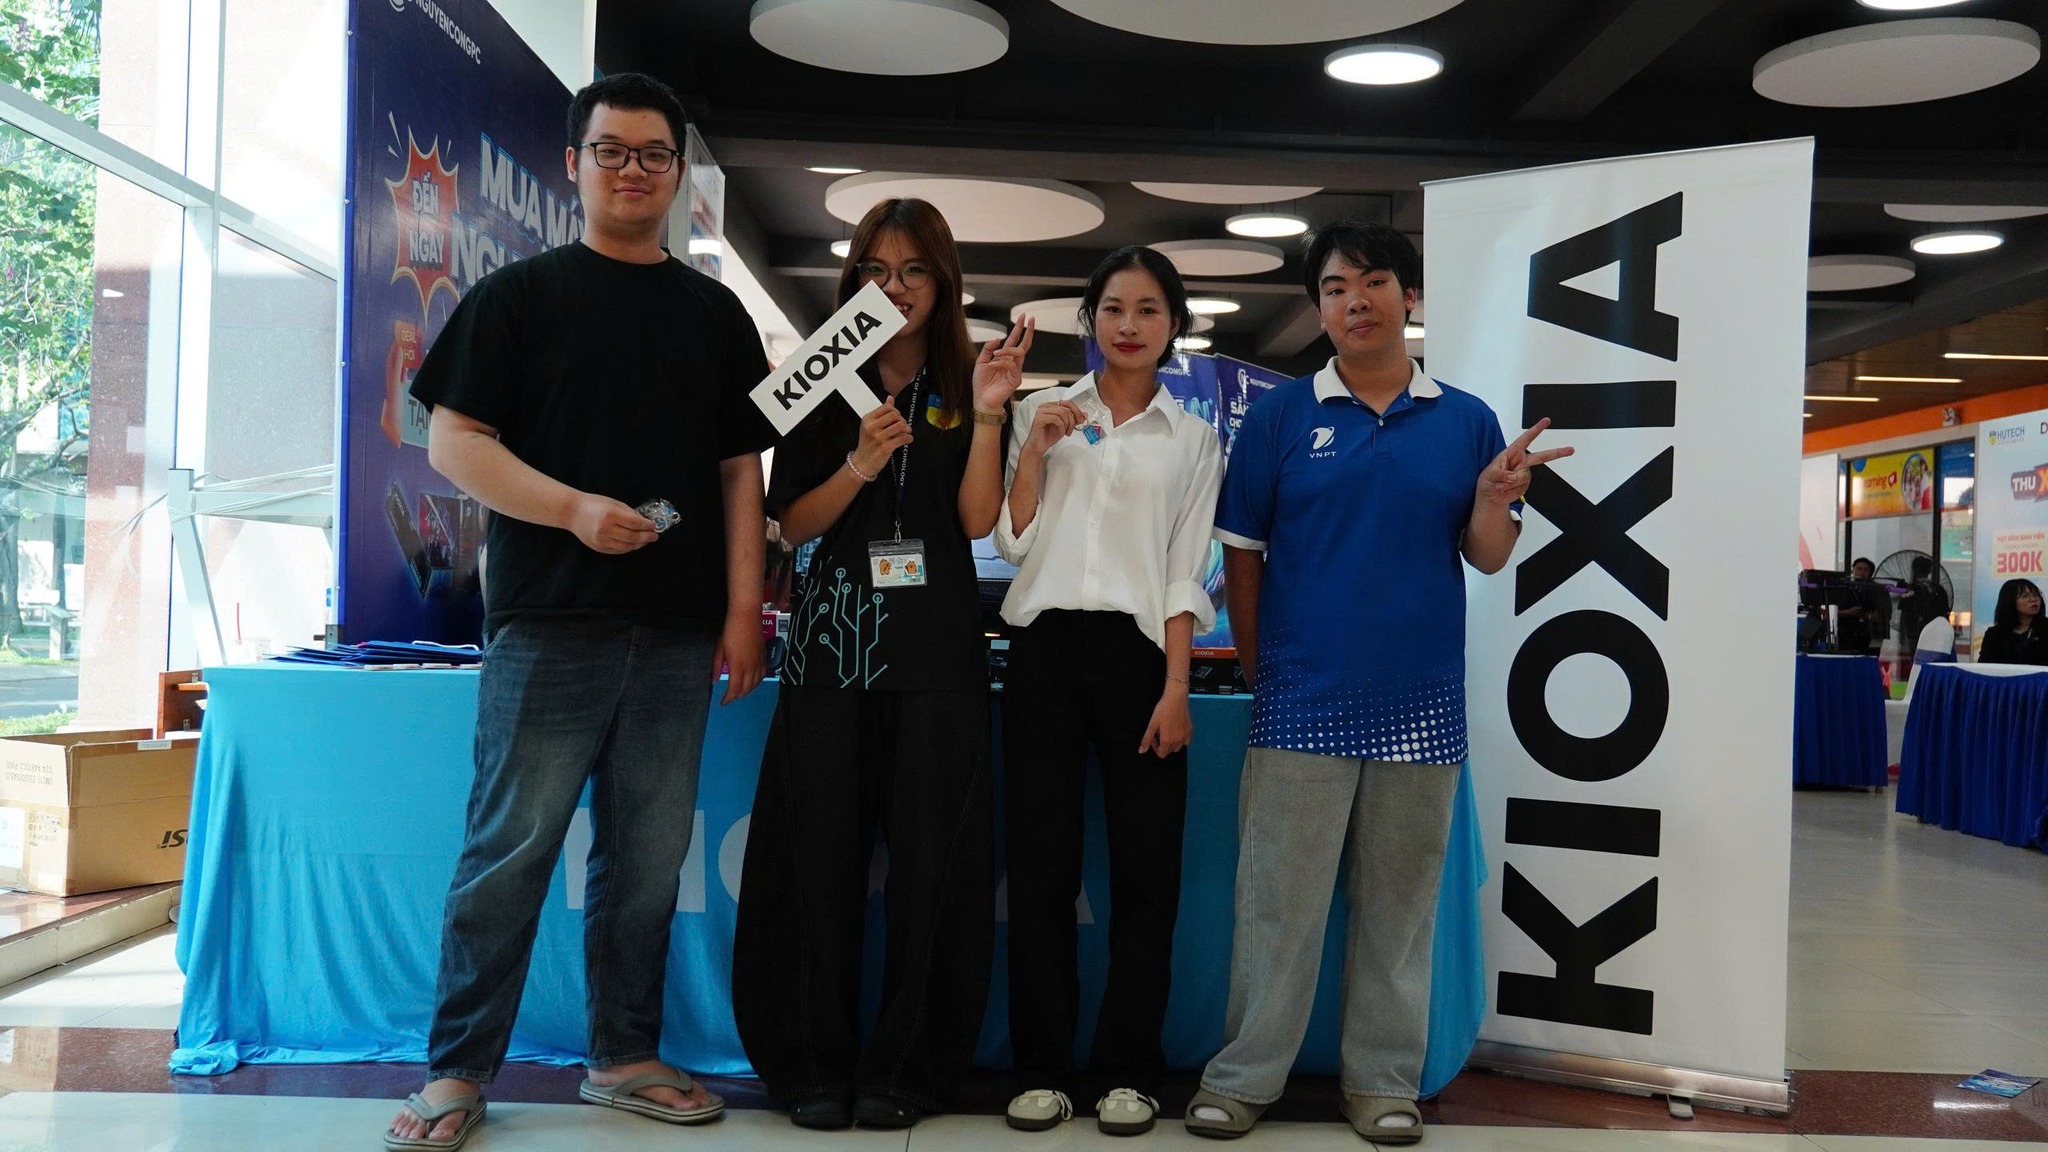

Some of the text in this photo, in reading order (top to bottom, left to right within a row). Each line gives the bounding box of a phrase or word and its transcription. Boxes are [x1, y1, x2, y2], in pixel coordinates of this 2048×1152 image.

[481, 133, 544, 240] MUA
[410, 229, 445, 263] NGAY
[772, 310, 882, 411] KIOXIA
[1997, 426, 2025, 440] HUTECH
[900, 444, 909, 487] ECHNOLOGY
[1309, 451, 1337, 459] VNPT
[2012, 476, 2036, 492] THU
[1997, 550, 2043, 573] 300K
[1496, 191, 1684, 1036] KIOXIA
